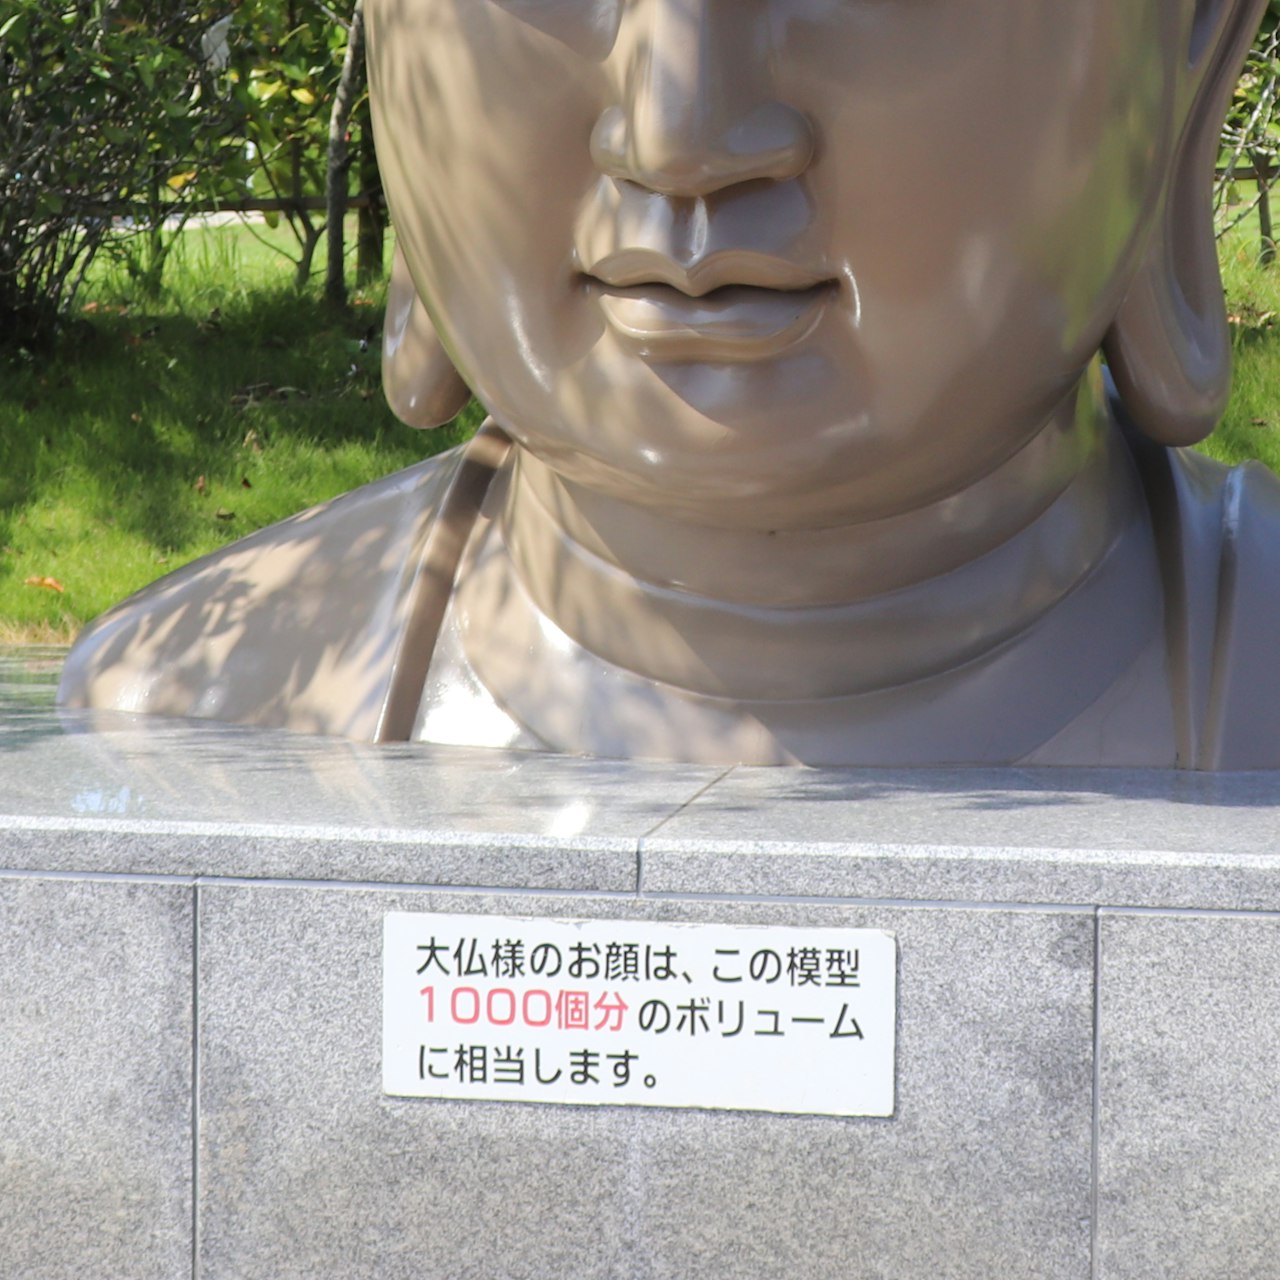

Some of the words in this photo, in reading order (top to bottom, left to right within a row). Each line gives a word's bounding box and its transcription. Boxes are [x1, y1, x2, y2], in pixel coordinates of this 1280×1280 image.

[416, 935, 861, 988] 大仏様のお顔は、この模型
[418, 1043, 658, 1089] に相当します。
